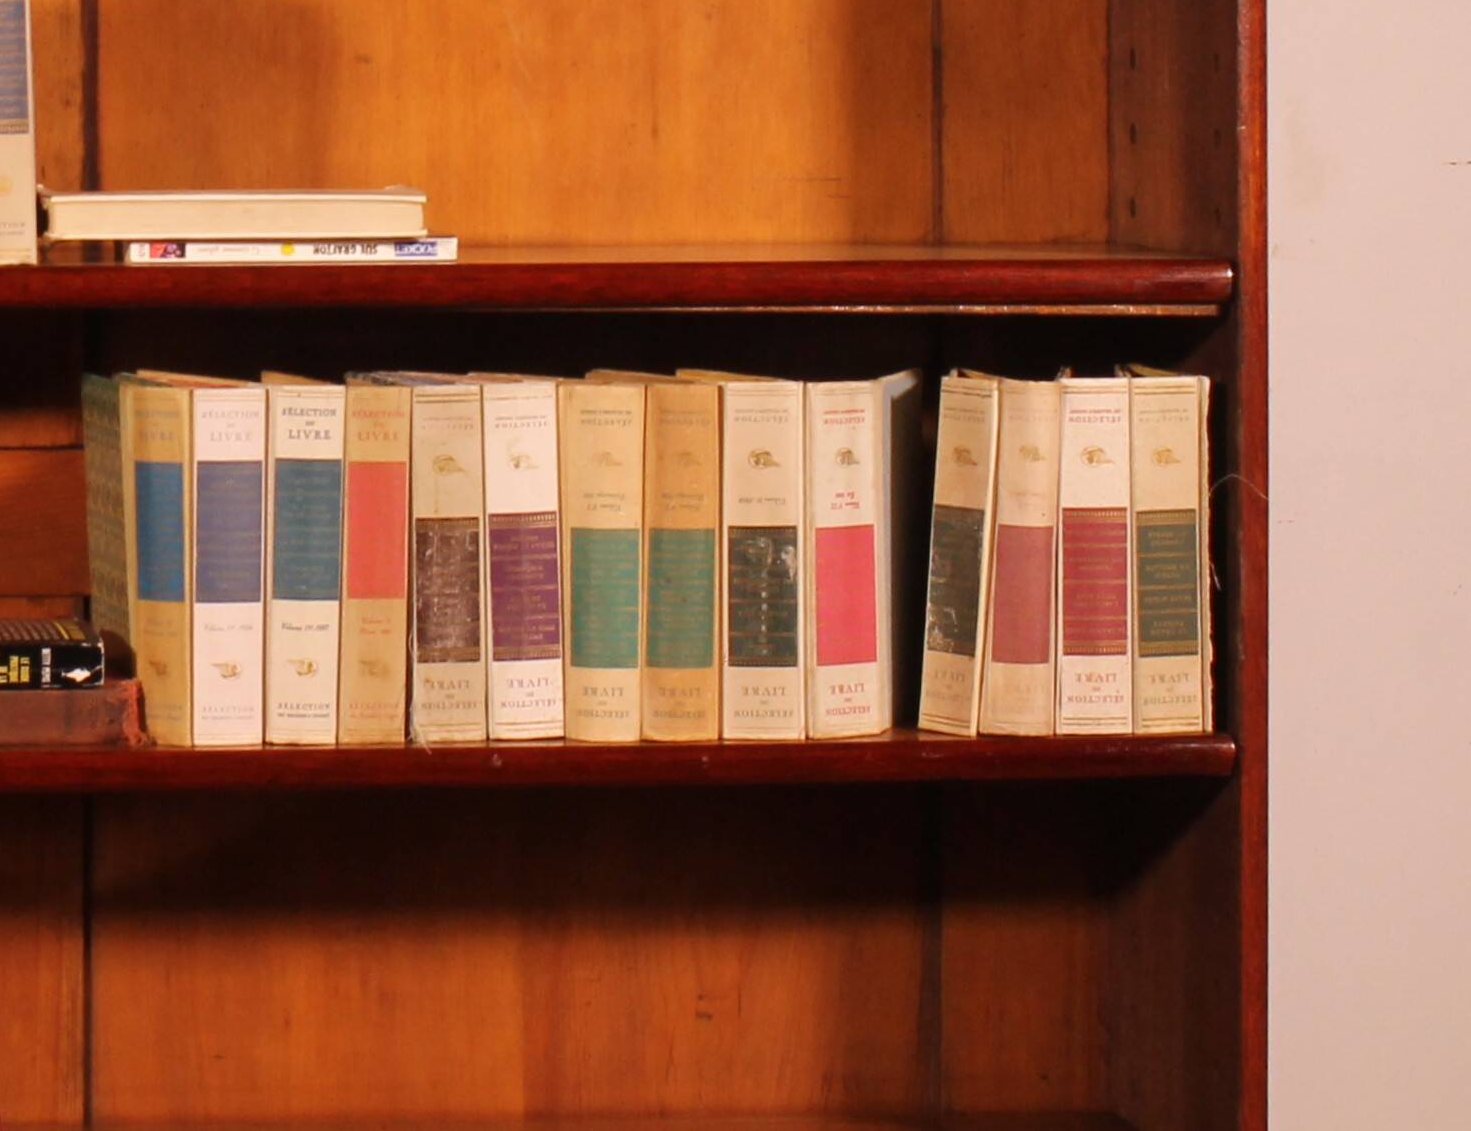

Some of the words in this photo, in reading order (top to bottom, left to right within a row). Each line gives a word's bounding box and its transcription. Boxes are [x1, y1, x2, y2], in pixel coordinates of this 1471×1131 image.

[210, 432, 252, 442] LIVRE
[289, 430, 331, 440] LIVRE
[358, 431, 398, 440] LIVRE
[507, 678, 548, 688] LIVRE
[1075, 673, 1117, 683] LIVRE
[1148, 673, 1189, 684] LIVRE
[582, 686, 624, 696] LIVRE
[742, 686, 785, 696] LIVRE
[829, 683, 865, 694] LIVRE
